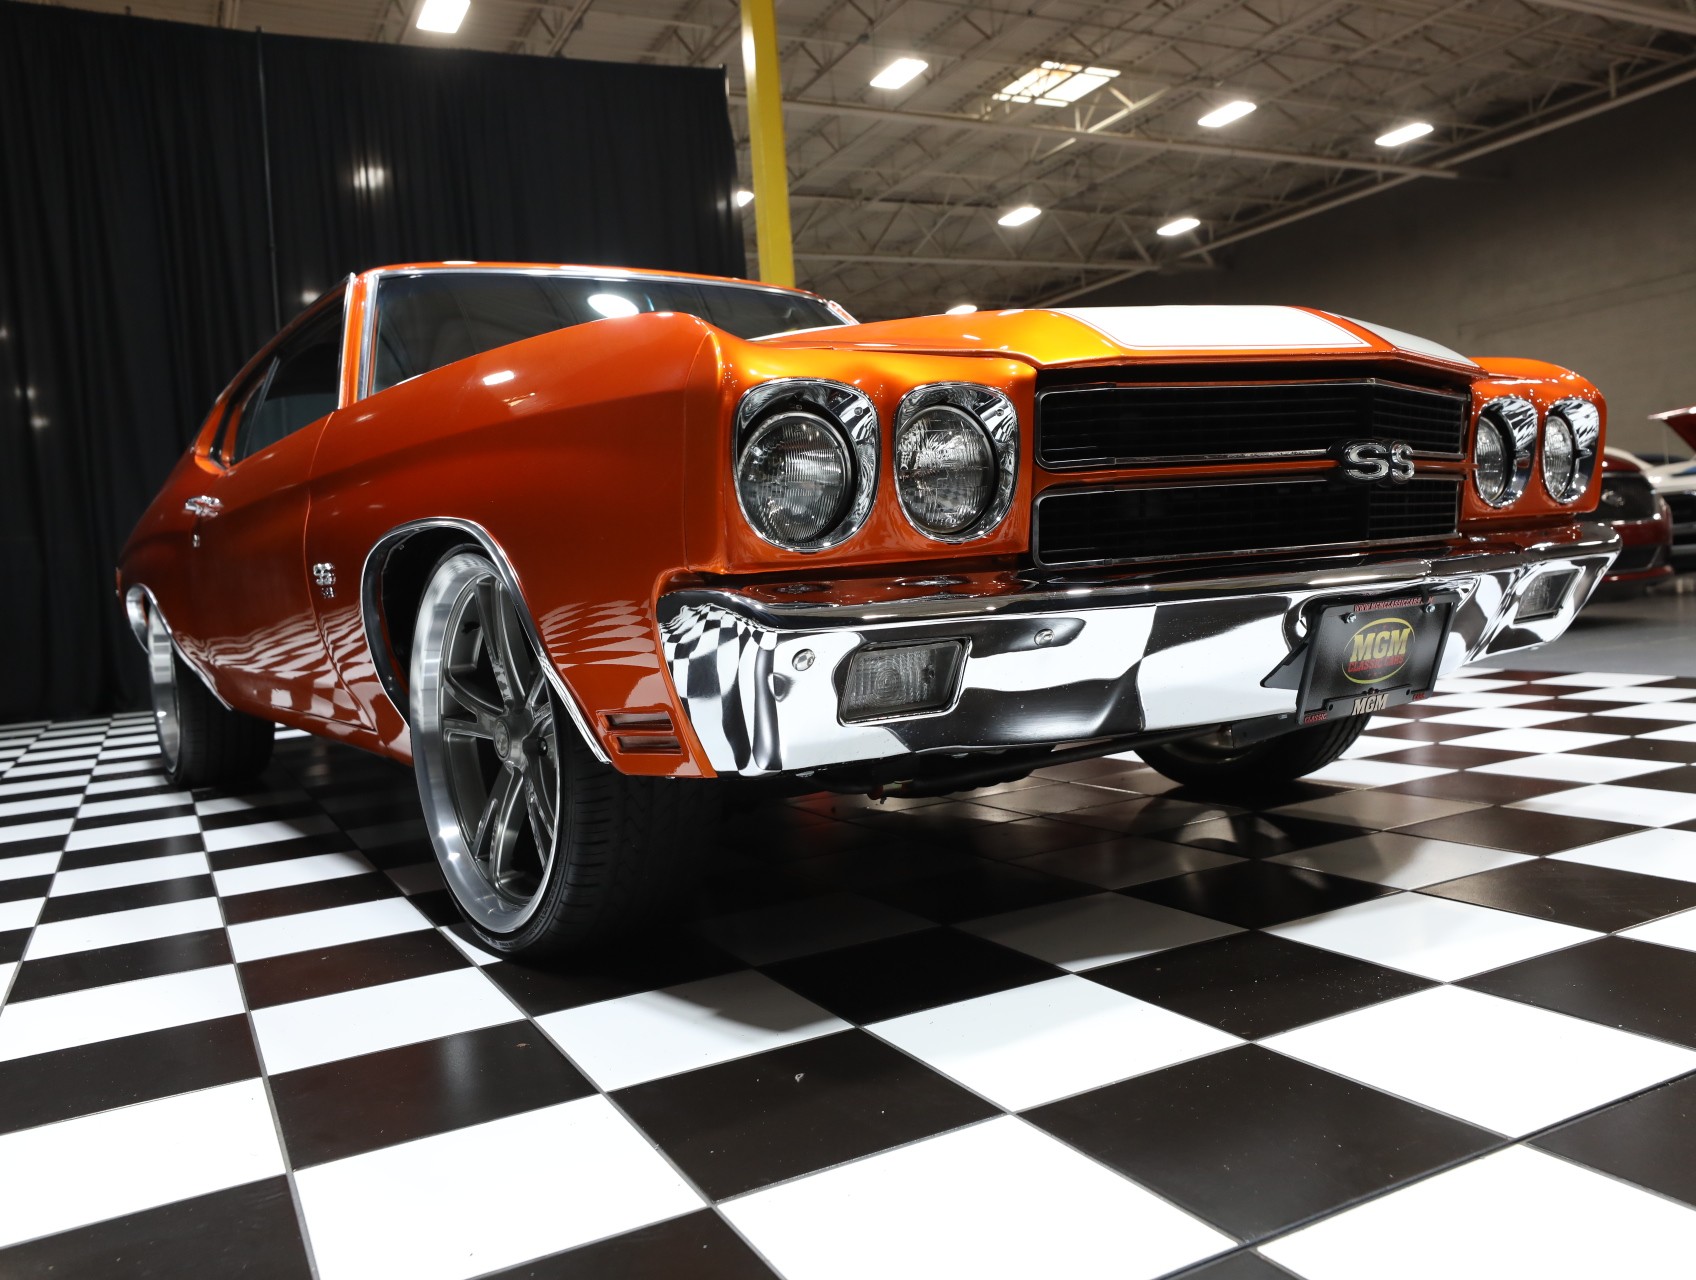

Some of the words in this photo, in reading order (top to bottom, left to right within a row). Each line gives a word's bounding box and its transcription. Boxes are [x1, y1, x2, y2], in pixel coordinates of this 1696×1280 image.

[1344, 443, 1415, 484] SS
[1354, 596, 1435, 612] WWW.MGMCLASSICCARS.M
[1349, 627, 1411, 662] MGM
[1347, 659, 1384, 673] CLASSIC
[1352, 694, 1389, 716] MGM
